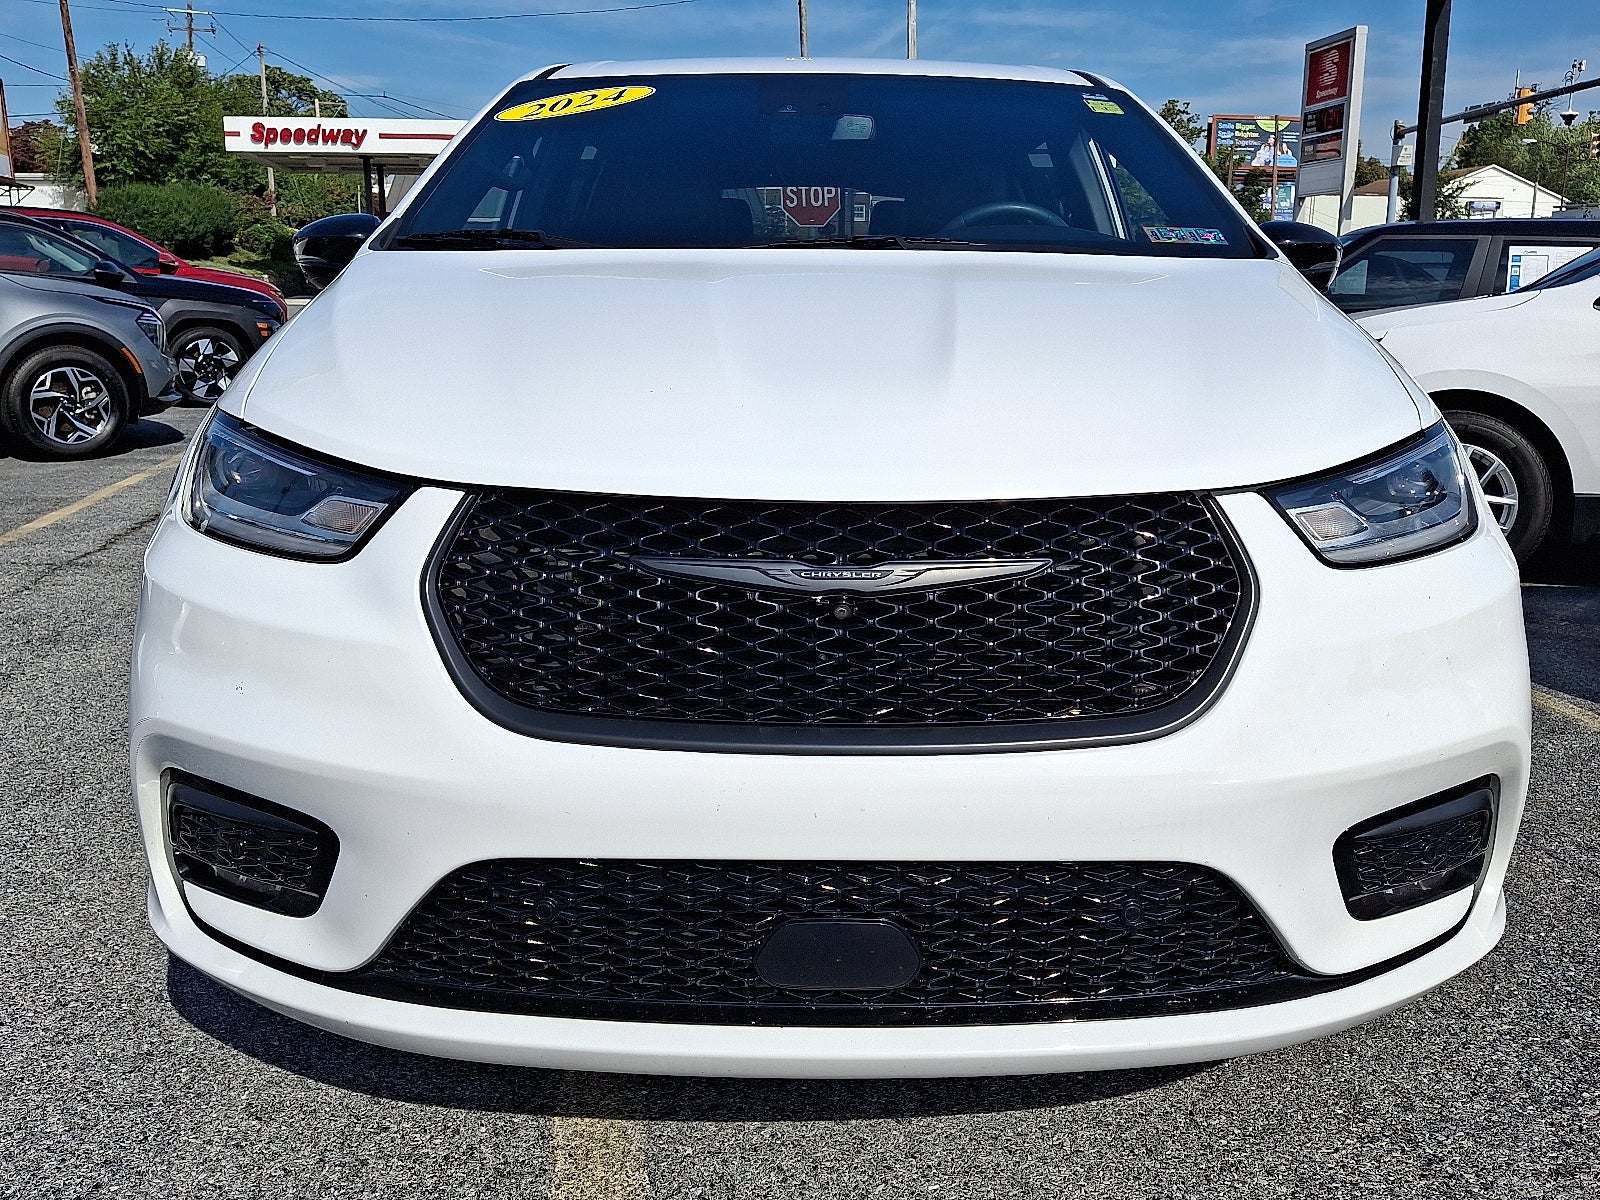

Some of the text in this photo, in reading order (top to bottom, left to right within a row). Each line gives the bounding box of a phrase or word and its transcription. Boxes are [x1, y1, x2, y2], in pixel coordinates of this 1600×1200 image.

[520, 88, 628, 119] 2024
[1315, 87, 1339, 99] Speedway
[250, 122, 368, 150] Speedway
[1218, 122, 1235, 130] Smile
[785, 186, 836, 208] STOP
